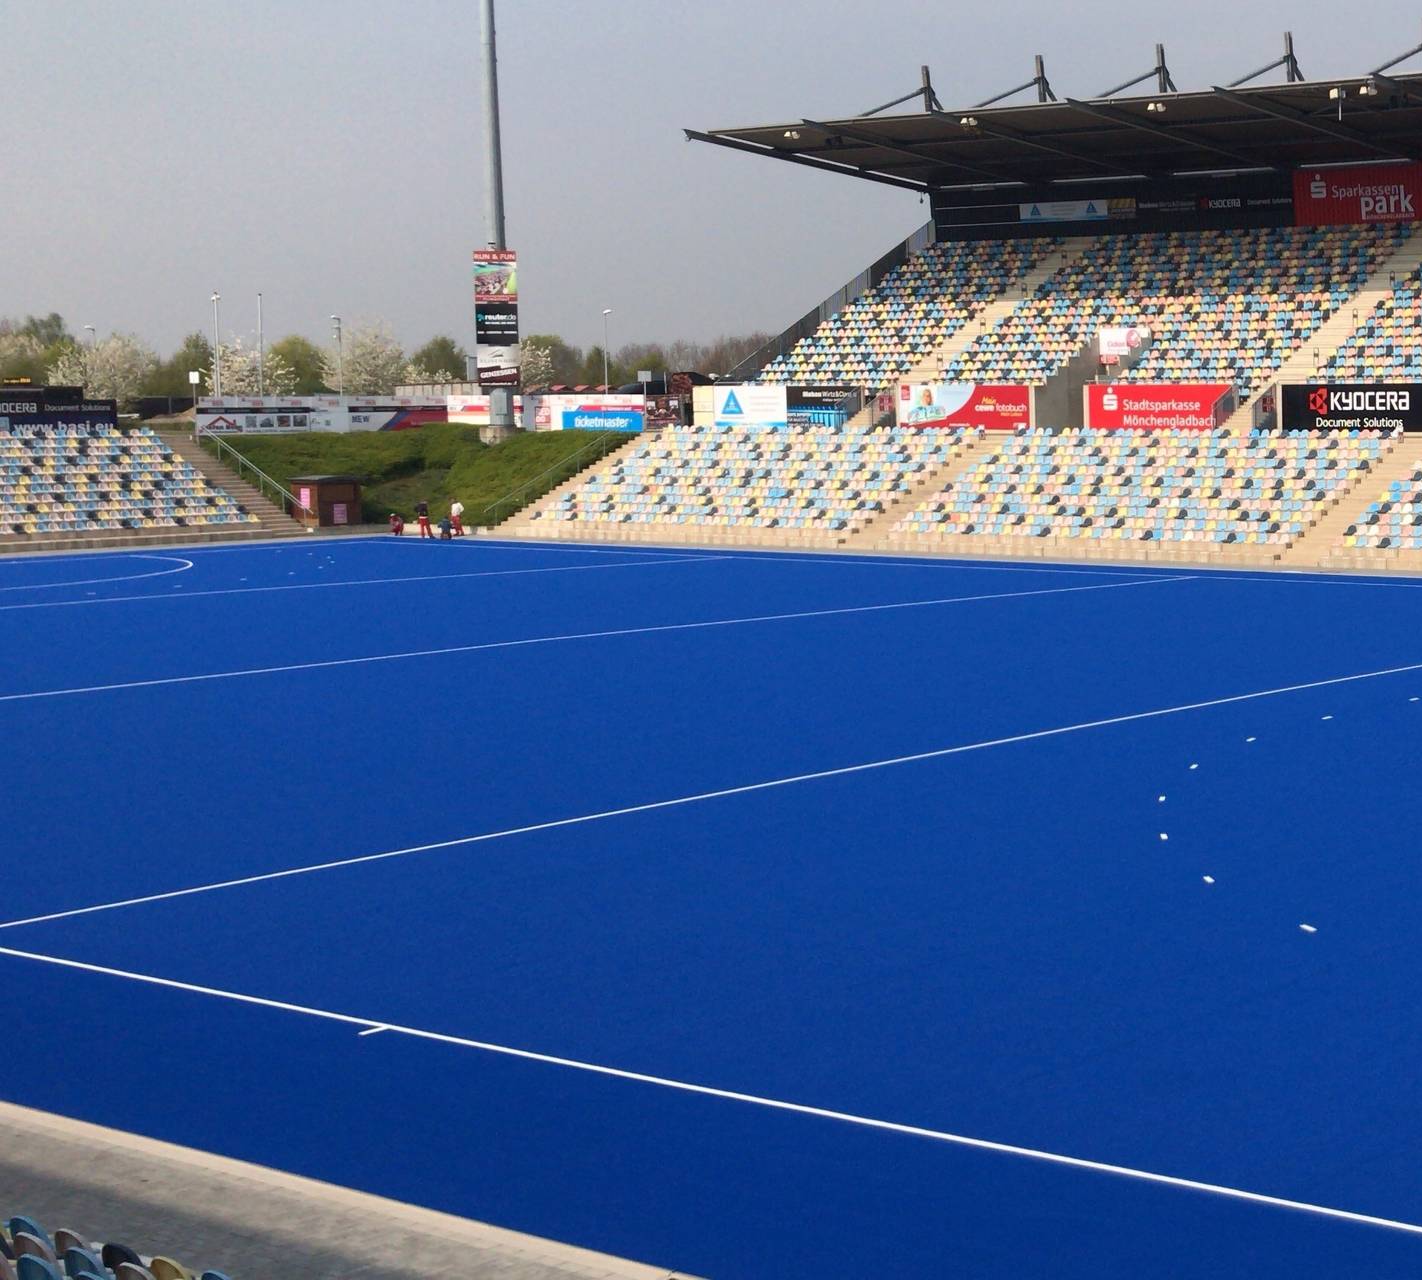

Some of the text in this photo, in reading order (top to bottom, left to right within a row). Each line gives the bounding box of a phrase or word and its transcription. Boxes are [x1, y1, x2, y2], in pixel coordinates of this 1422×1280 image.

[1331, 183, 1400, 201] Sparkassen
[1360, 184, 1415, 220] park
[500, 252, 516, 260] FUN
[996, 403, 1028, 413] fotobuch
[1123, 398, 1201, 412] Stadtsparkasse
[1330, 391, 1410, 411] KYOCERA
[1123, 414, 1217, 428] Mönchengladbach
[1315, 417, 1404, 428] Document Solutions
